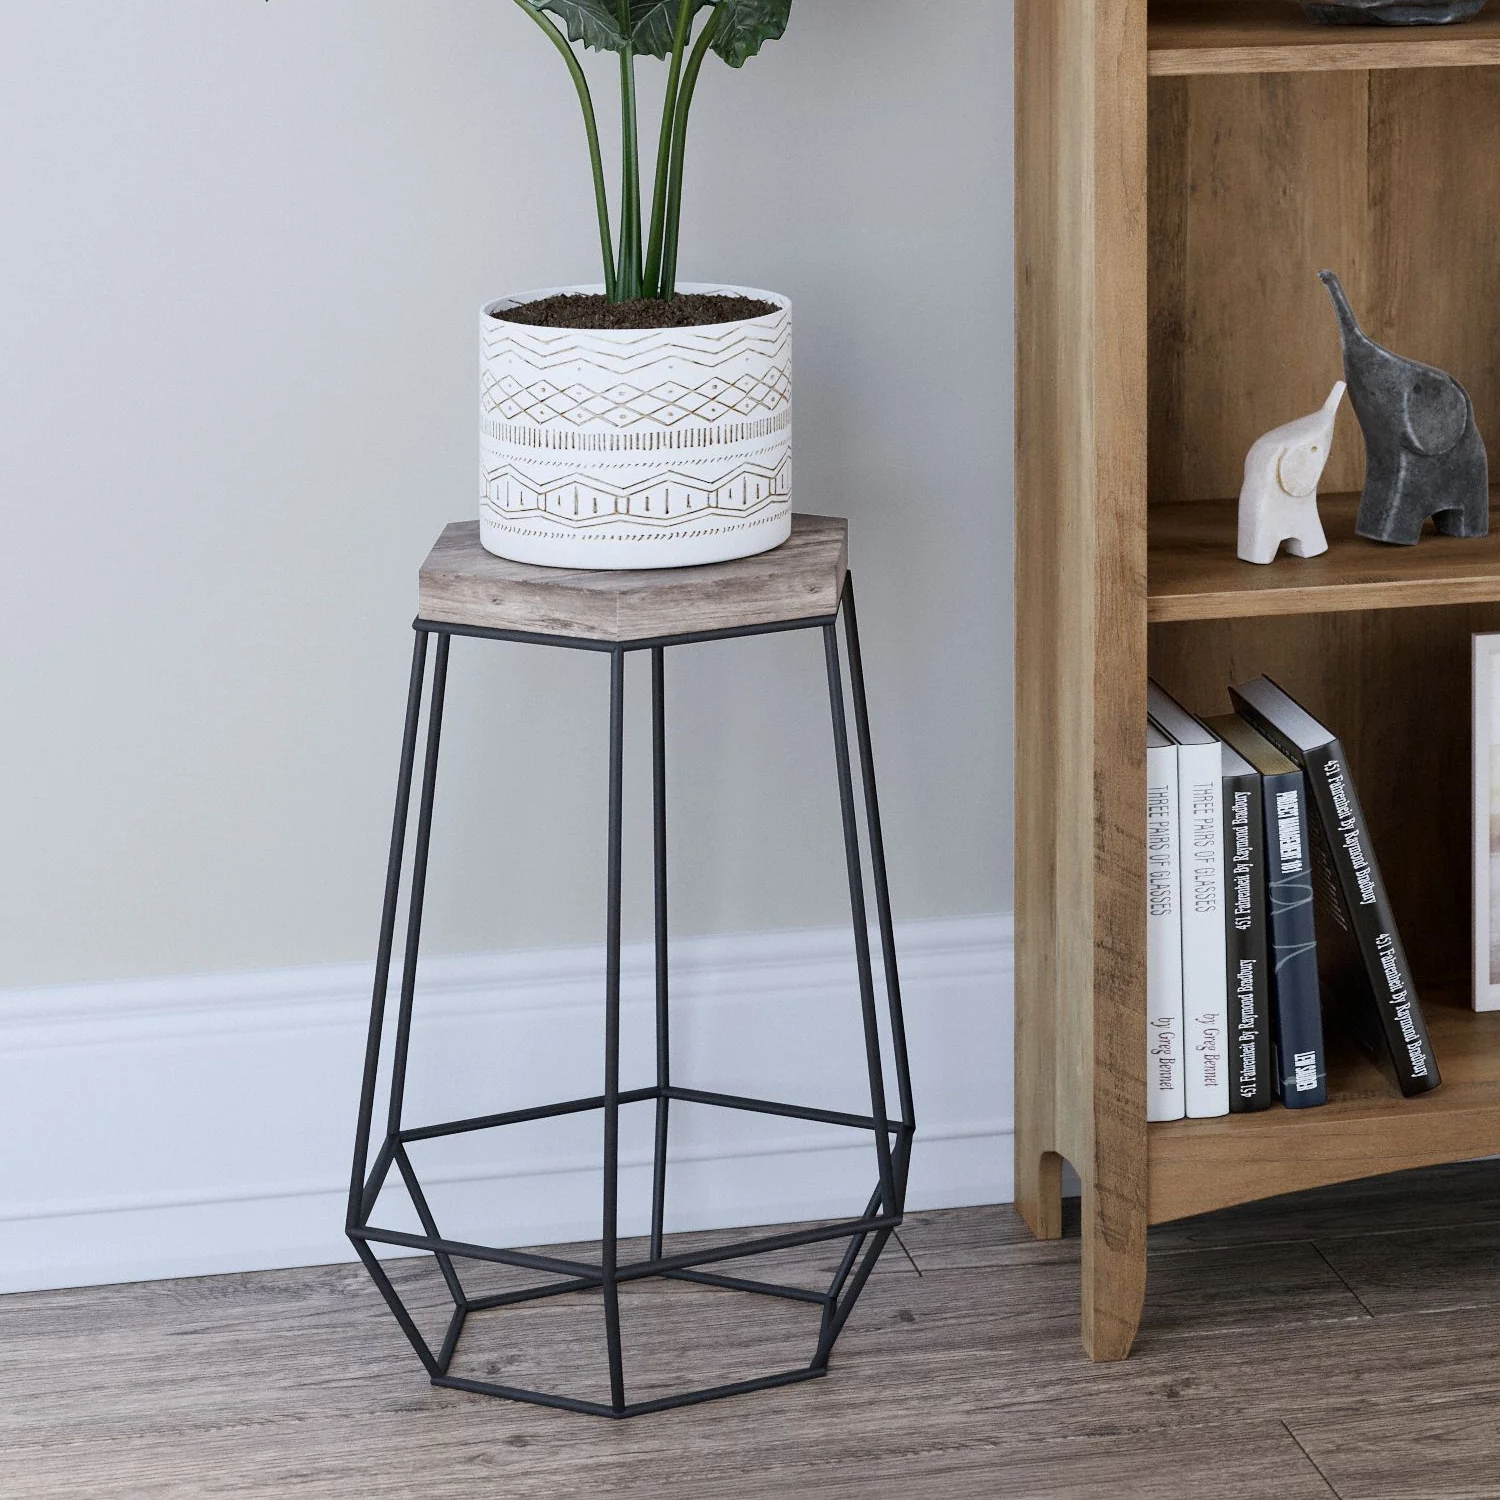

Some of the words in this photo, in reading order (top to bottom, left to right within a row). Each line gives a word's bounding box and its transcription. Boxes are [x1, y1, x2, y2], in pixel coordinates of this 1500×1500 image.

[1323, 759, 1340, 777] 451
[1148, 785, 1169, 818] THREE
[1193, 782, 1214, 815] THREE
[1231, 791, 1252, 825] Bradbury
[1276, 790, 1300, 818] PROJECT
[1328, 774, 1353, 819] Fahrenheit
[1148, 821, 1170, 851] PAIRS
[1193, 817, 1215, 847] PAIRS
[1338, 815, 1356, 831] By
[1149, 854, 1171, 866] OF
[1194, 850, 1215, 863] OF
[1232, 825, 1253, 862] Raymond
[1343, 829, 1369, 869] Raymond
[1233, 863, 1254, 874] By
[1149, 870, 1172, 916] GLASSES
[1194, 867, 1216, 913] GLASSES
[1233, 874, 1251, 915] Fahrenheit
[1355, 866, 1377, 905] Bradbury
[1234, 915, 1252, 930] 451
[1375, 933, 1392, 950] 451
[1236, 959, 1257, 993] Bradbury
[1379, 947, 1404, 993] Fahrenheit
[1238, 993, 1259, 1030] Raymond
[1389, 989, 1408, 1004] By
[1150, 1017, 1175, 1029] by
[1195, 1013, 1220, 1025] by
[1238, 1030, 1259, 1041] By
[1394, 1002, 1420, 1043] Raymond
[1150, 1031, 1175, 1055] Greg
[1195, 1028, 1220, 1051] Greg
[1159, 1058, 1176, 1091] Bennet
[1203, 1054, 1220, 1087] Bennet
[1239, 1041, 1256, 1082] Fahrenheit
[1406, 1039, 1428, 1078] Bradbury
[1240, 1083, 1257, 1097] 451
